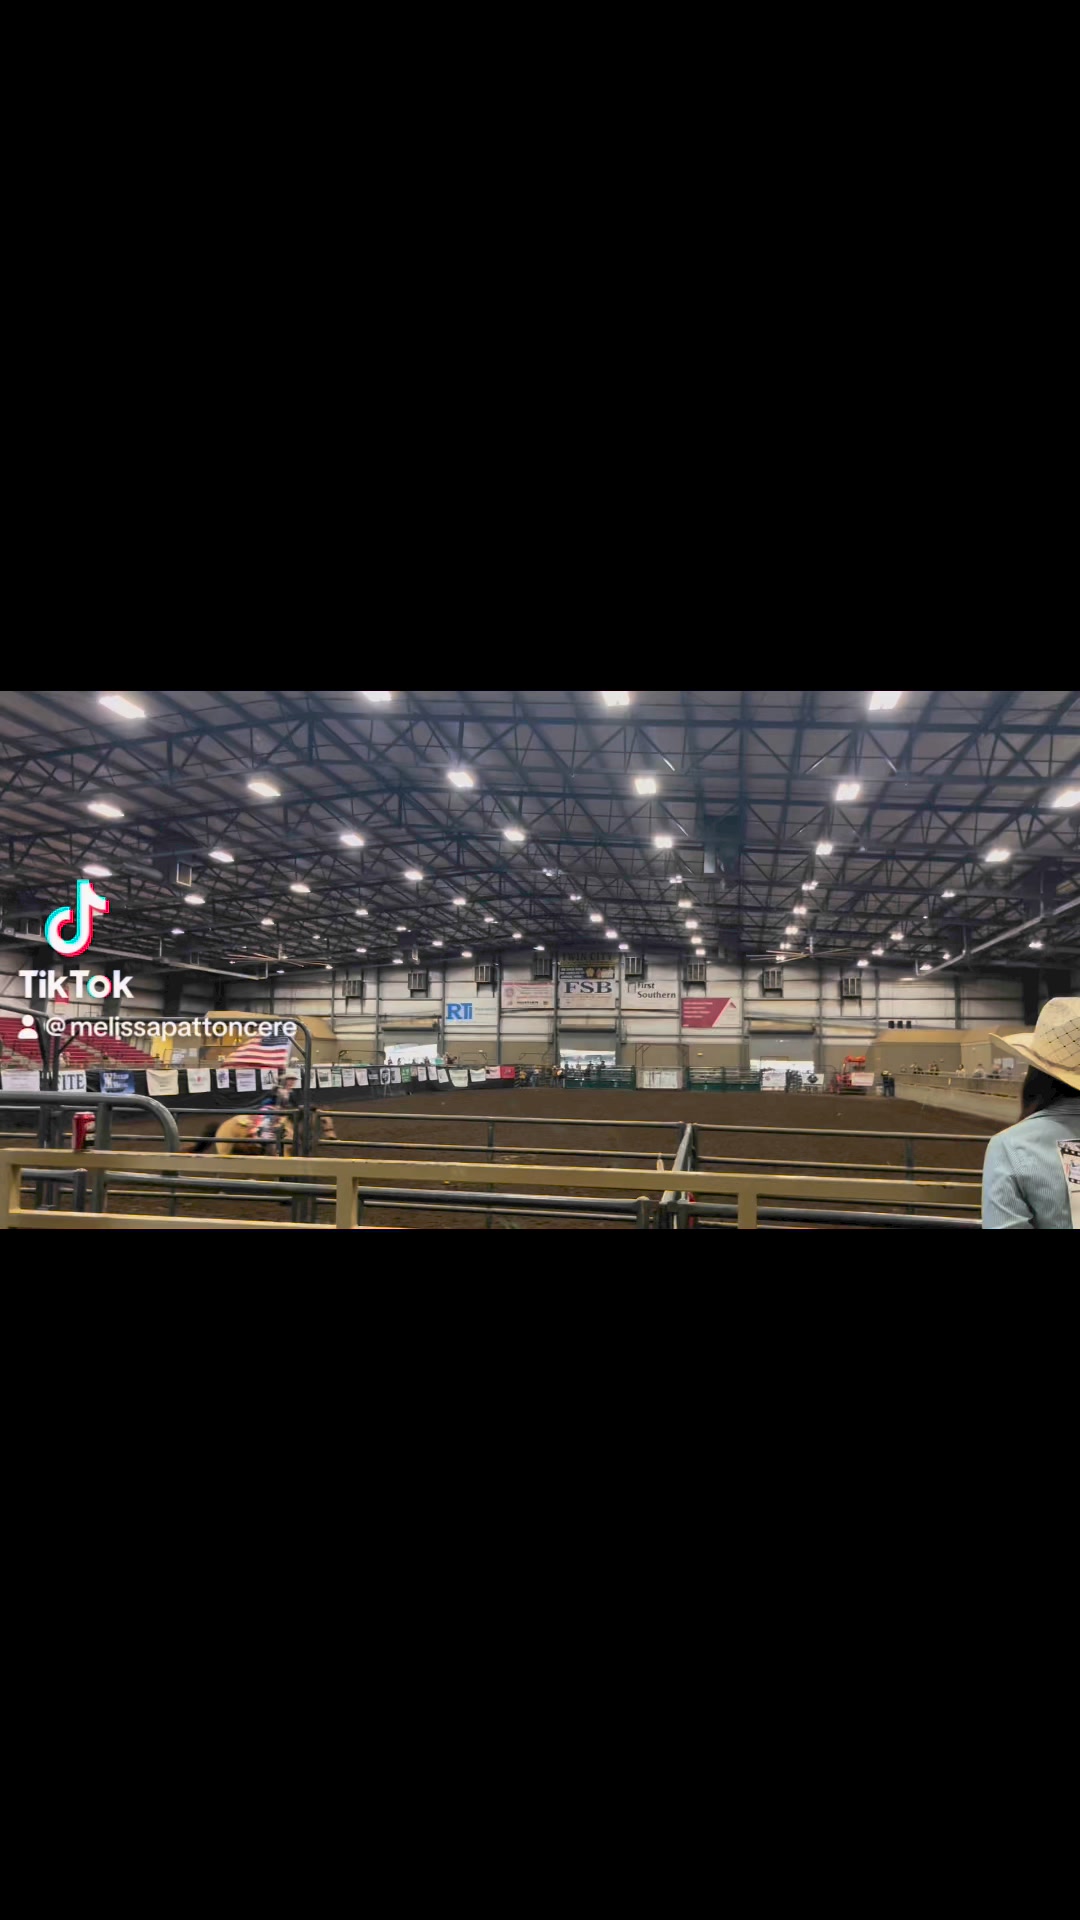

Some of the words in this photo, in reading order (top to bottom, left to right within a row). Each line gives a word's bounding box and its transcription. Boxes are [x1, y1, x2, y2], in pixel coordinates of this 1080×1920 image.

[590, 952, 612, 961] CITY
[564, 981, 612, 994] FSB
[637, 981, 655, 989] First
[637, 991, 676, 999] Southern
